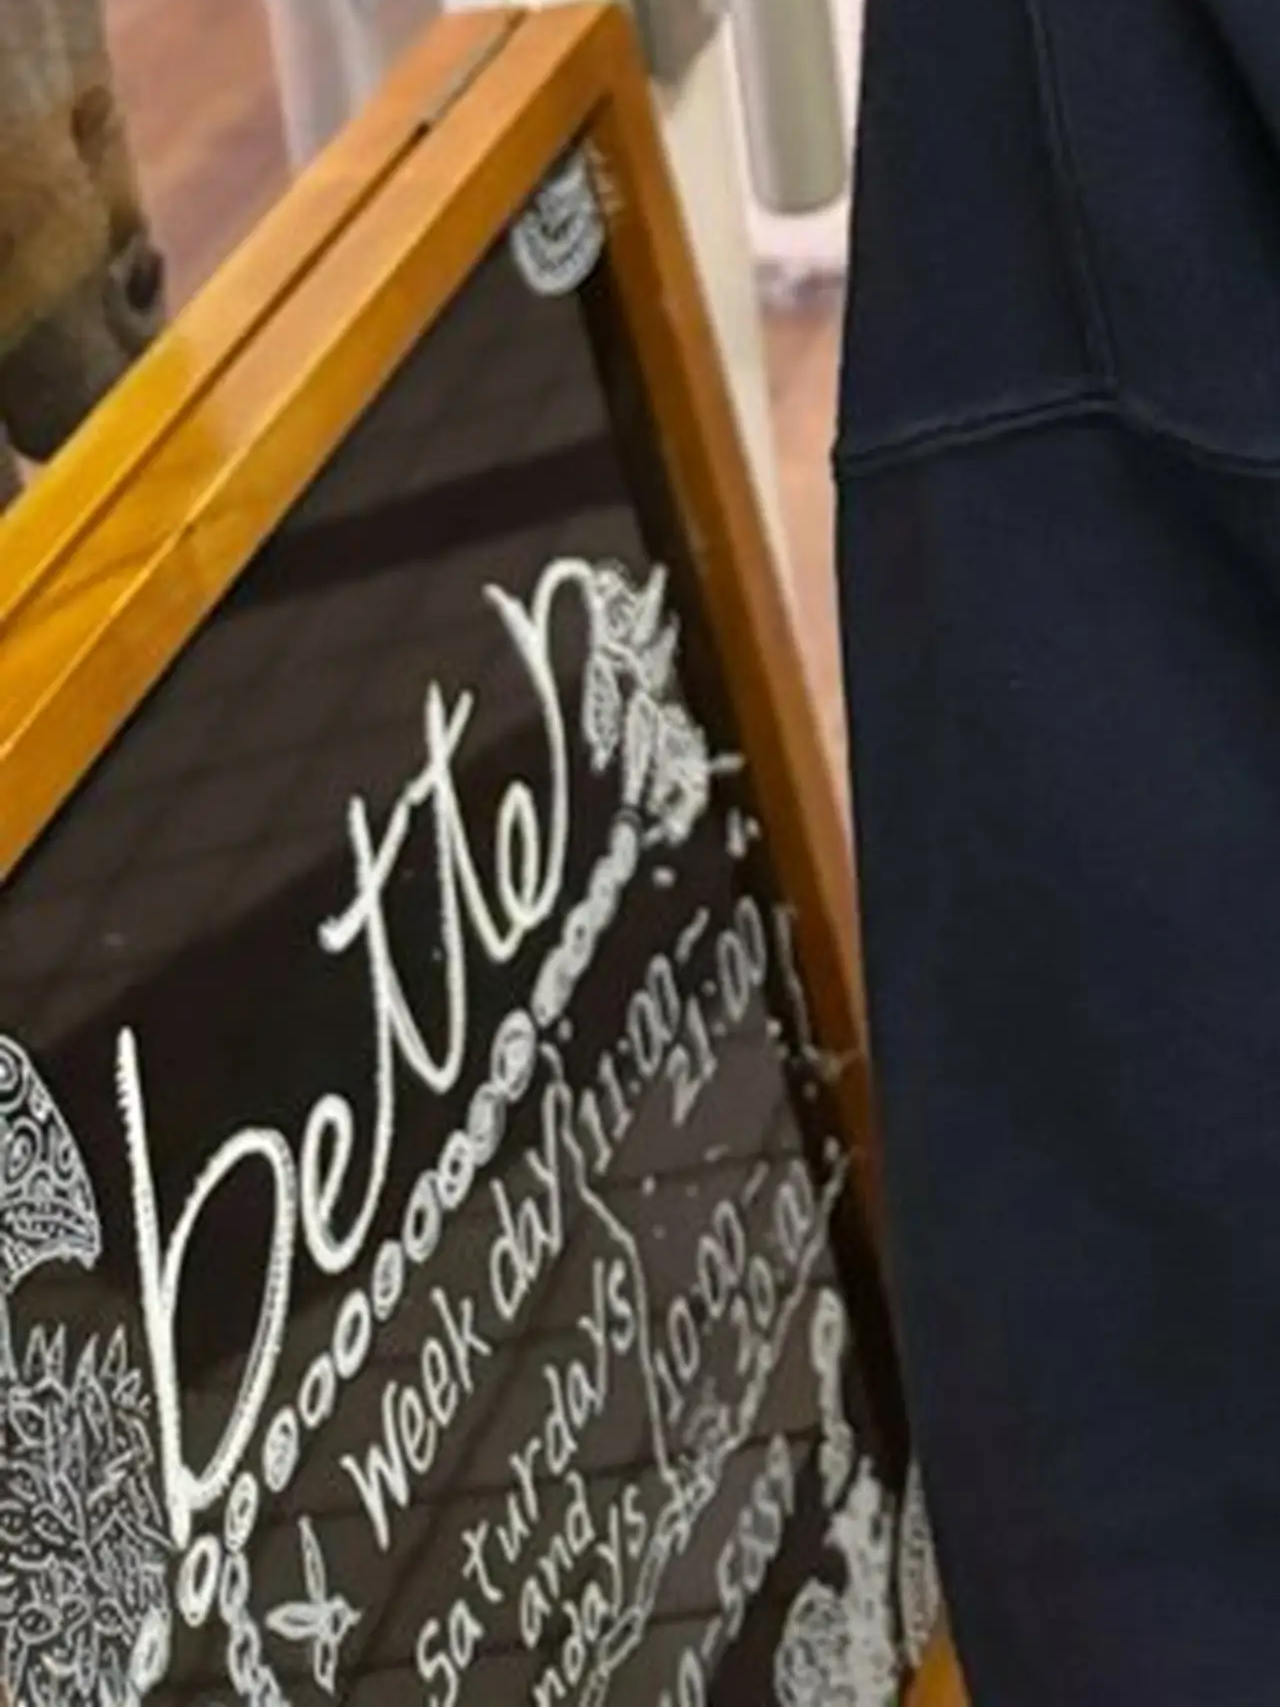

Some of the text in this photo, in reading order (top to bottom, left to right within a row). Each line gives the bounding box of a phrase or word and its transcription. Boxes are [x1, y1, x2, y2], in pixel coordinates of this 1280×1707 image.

[115, 557, 603, 1549] better
[416, 1257, 635, 1707] Saturdays
[520, 1470, 596, 1649] and
